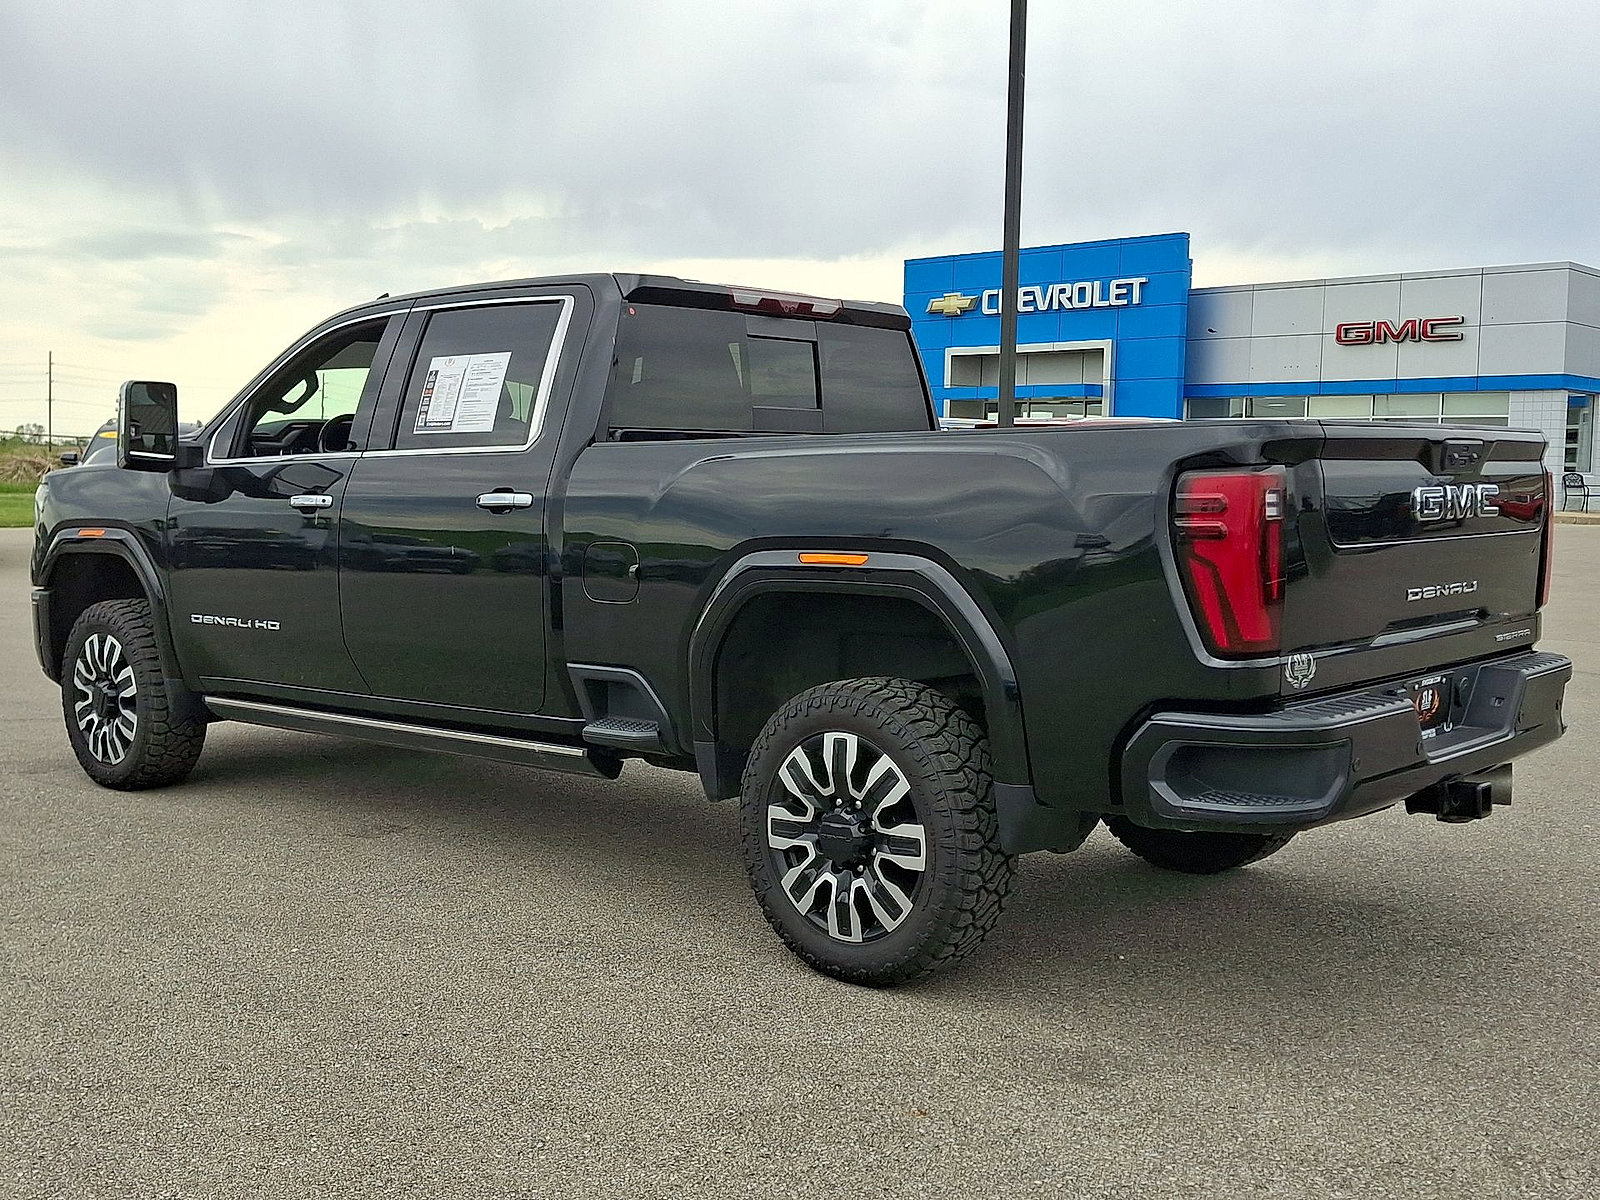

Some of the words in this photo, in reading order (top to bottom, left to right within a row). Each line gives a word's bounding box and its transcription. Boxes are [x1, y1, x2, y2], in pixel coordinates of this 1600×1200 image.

[981, 277, 1149, 315] CEVROLET
[1335, 315, 1464, 346] GMC
[1411, 484, 1501, 522] GMC
[1406, 580, 1479, 602] DENALI
[190, 613, 252, 629] DENALI
[254, 619, 281, 631] HD
[1494, 628, 1532, 643] SIERRA
